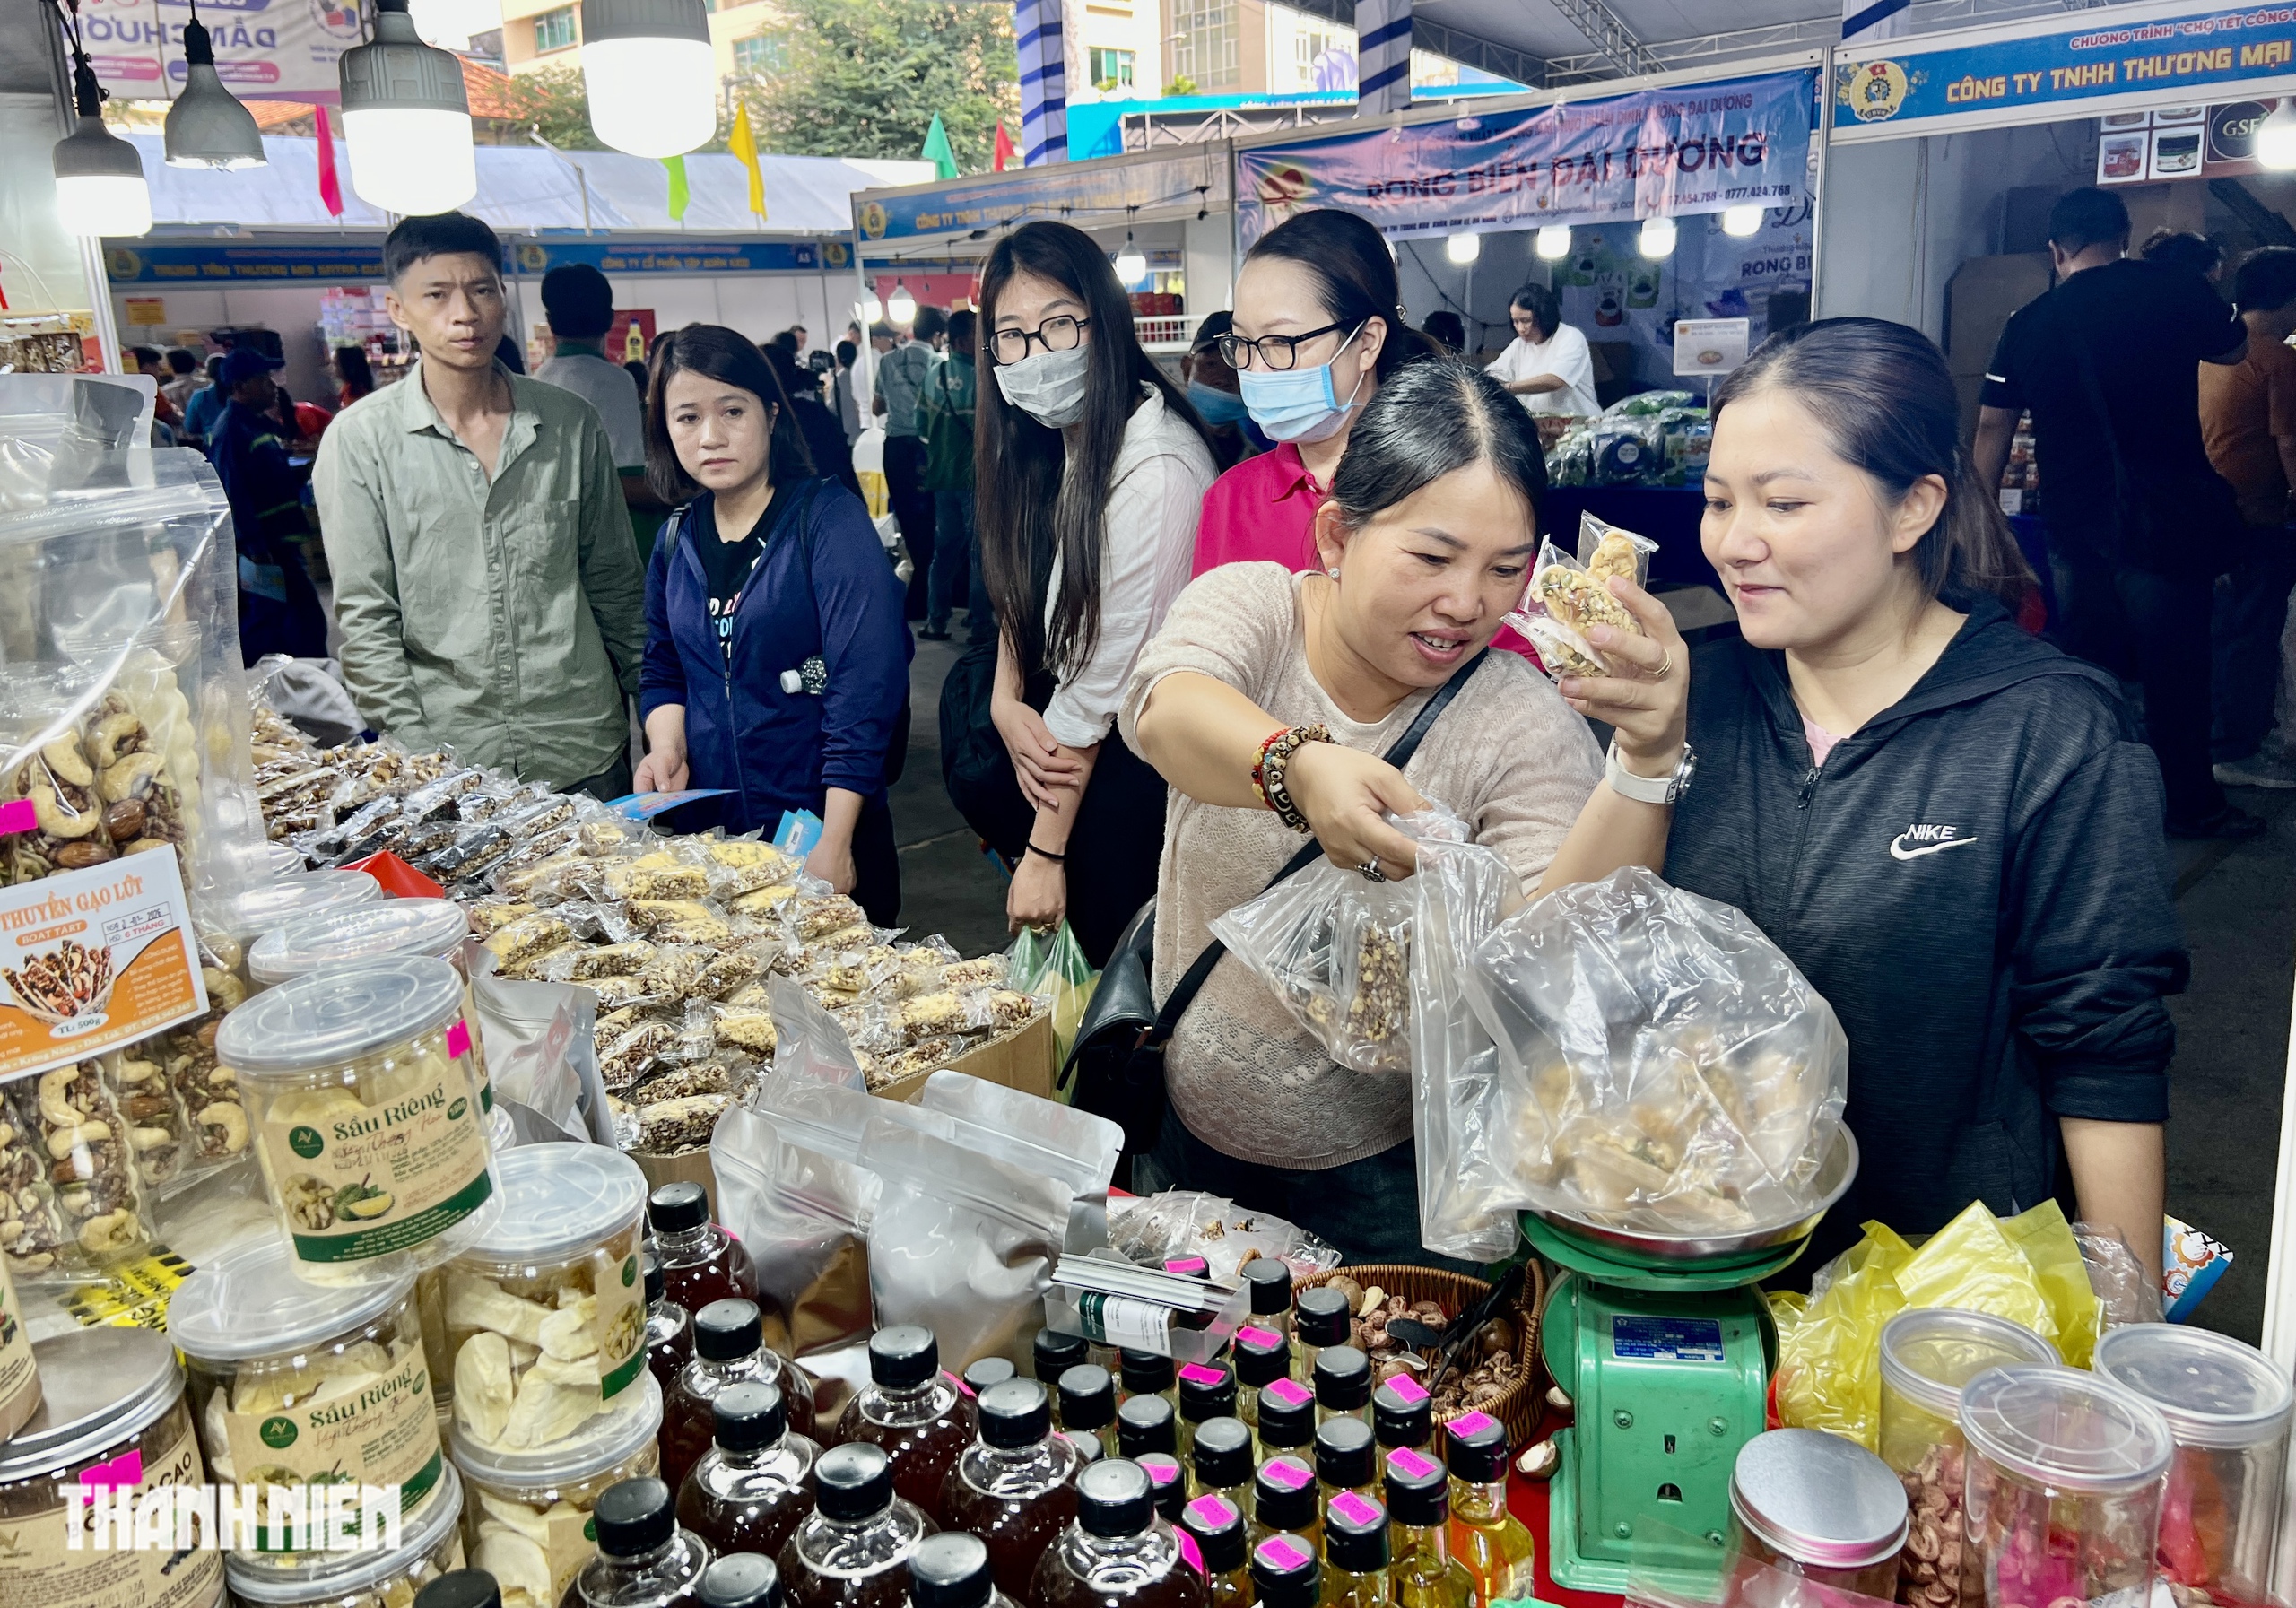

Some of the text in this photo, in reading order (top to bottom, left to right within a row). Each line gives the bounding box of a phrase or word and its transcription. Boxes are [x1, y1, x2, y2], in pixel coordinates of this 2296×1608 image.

[2070, 32, 2130, 49] CHƯƠNG
[2133, 24, 2173, 41] TRÌNH
[2245, 8, 2288, 26] CÔNG
[1946, 40, 2292, 103] CÔNG TY TNHH THƯƠNG MẠI
[1708, 89, 1752, 115] DƯƠNG
[1367, 170, 1457, 206] RONG
[914, 211, 940, 230] CÔNG
[1742, 256, 1792, 276] RONG
[1904, 824, 1956, 840] NIKE
[0, 890, 72, 932] THUYỀN
[76, 887, 111, 913] GẠO
[22, 922, 82, 944] BOAT TART
[125, 930, 131, 938] 6
[132, 919, 165, 937] THÁNG
[58, 1018, 101, 1034] TL: 500g
[333, 1082, 446, 1141] Sầu Riêng
[309, 1362, 413, 1429] Sầu Riêng
